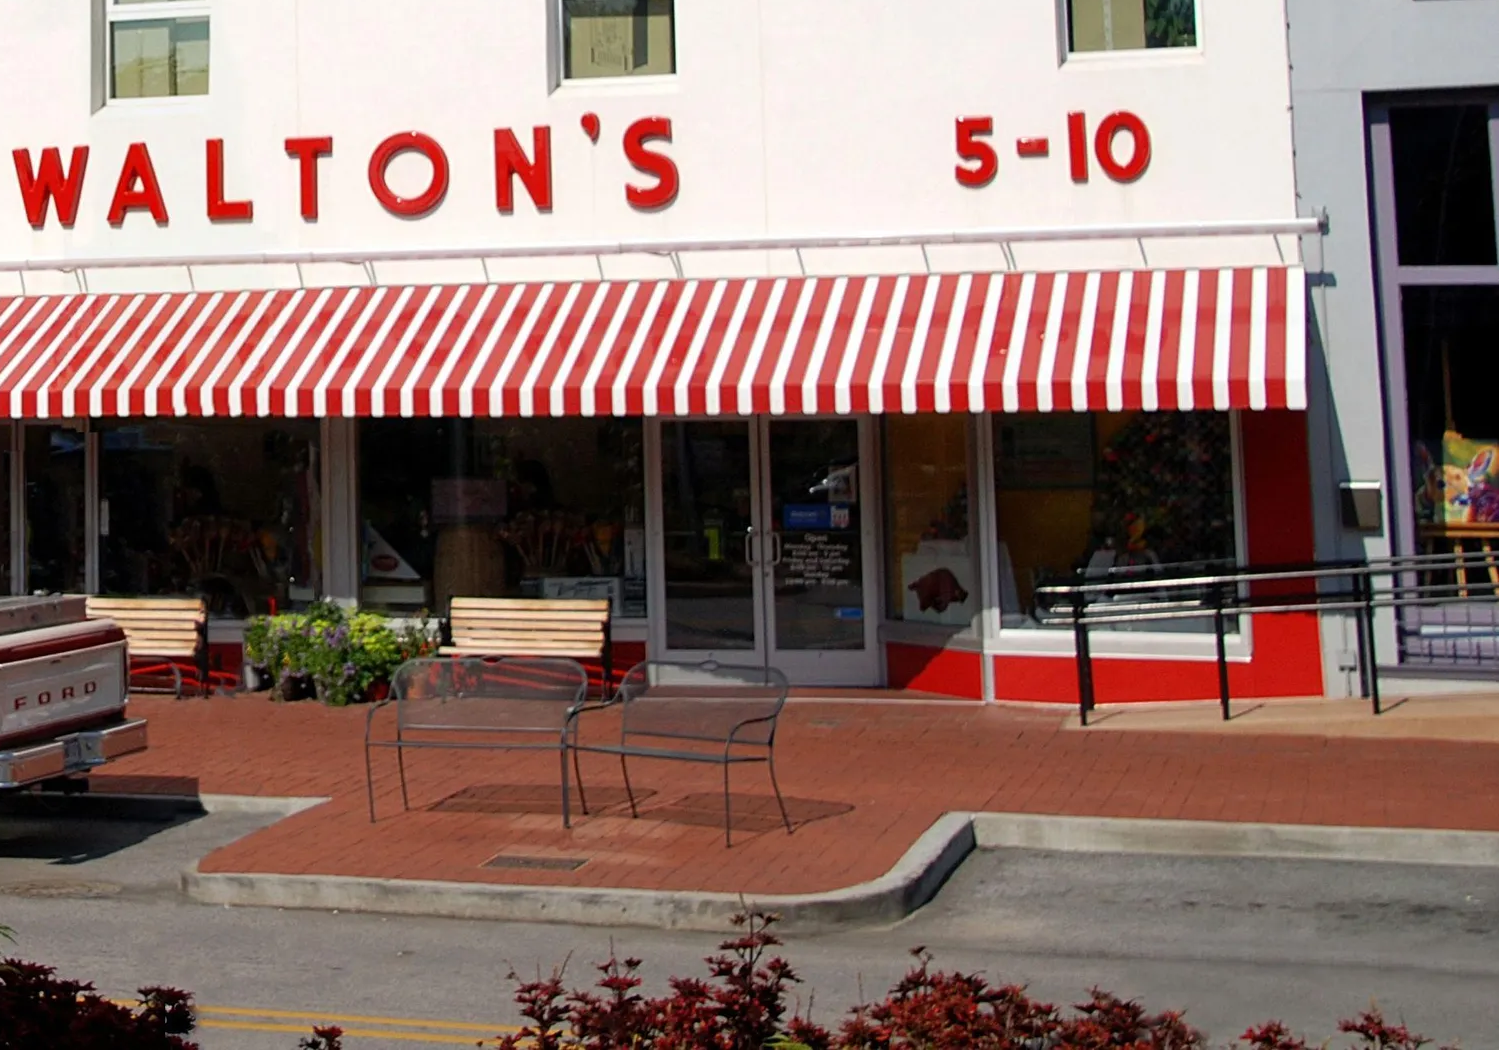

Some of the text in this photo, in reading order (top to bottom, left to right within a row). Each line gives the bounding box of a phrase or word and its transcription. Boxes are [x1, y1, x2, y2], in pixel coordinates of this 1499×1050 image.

[12, 111, 679, 230] WALTON'S
[955, 110, 1152, 188] 5-10
[14, 681, 97, 710] FORD
